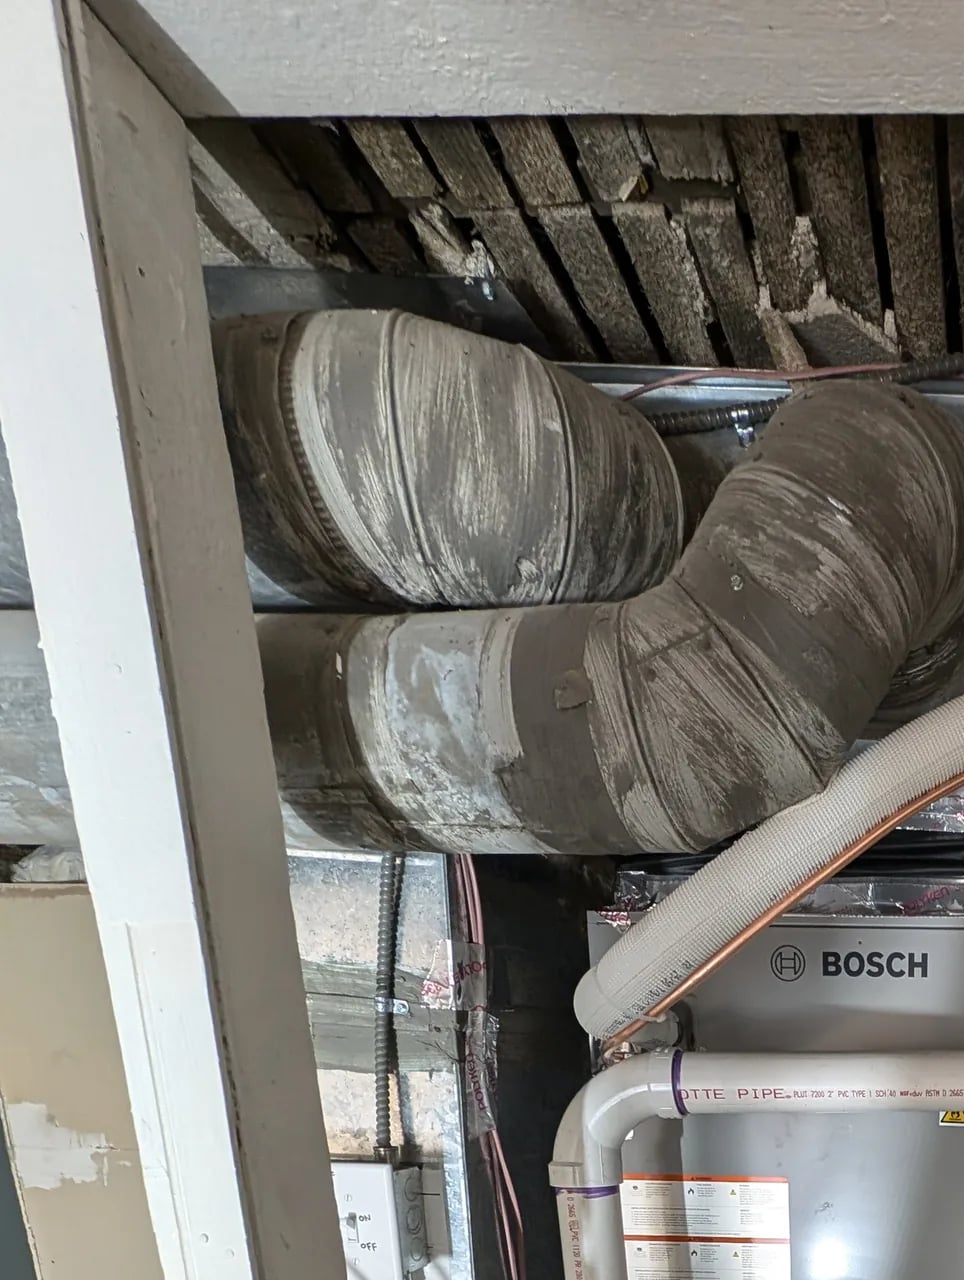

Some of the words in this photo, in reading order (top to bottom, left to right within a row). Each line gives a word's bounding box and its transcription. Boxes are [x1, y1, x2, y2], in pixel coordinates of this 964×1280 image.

[822, 951, 928, 978] BOSCH
[837, 1090, 849, 1098] PVC
[852, 1090, 866, 1098] TYPE
[925, 1088, 940, 1097] ASTM
[949, 1088, 964, 1097] 2665
[359, 1214, 371, 1223] ON
[360, 1242, 377, 1252] OFF
